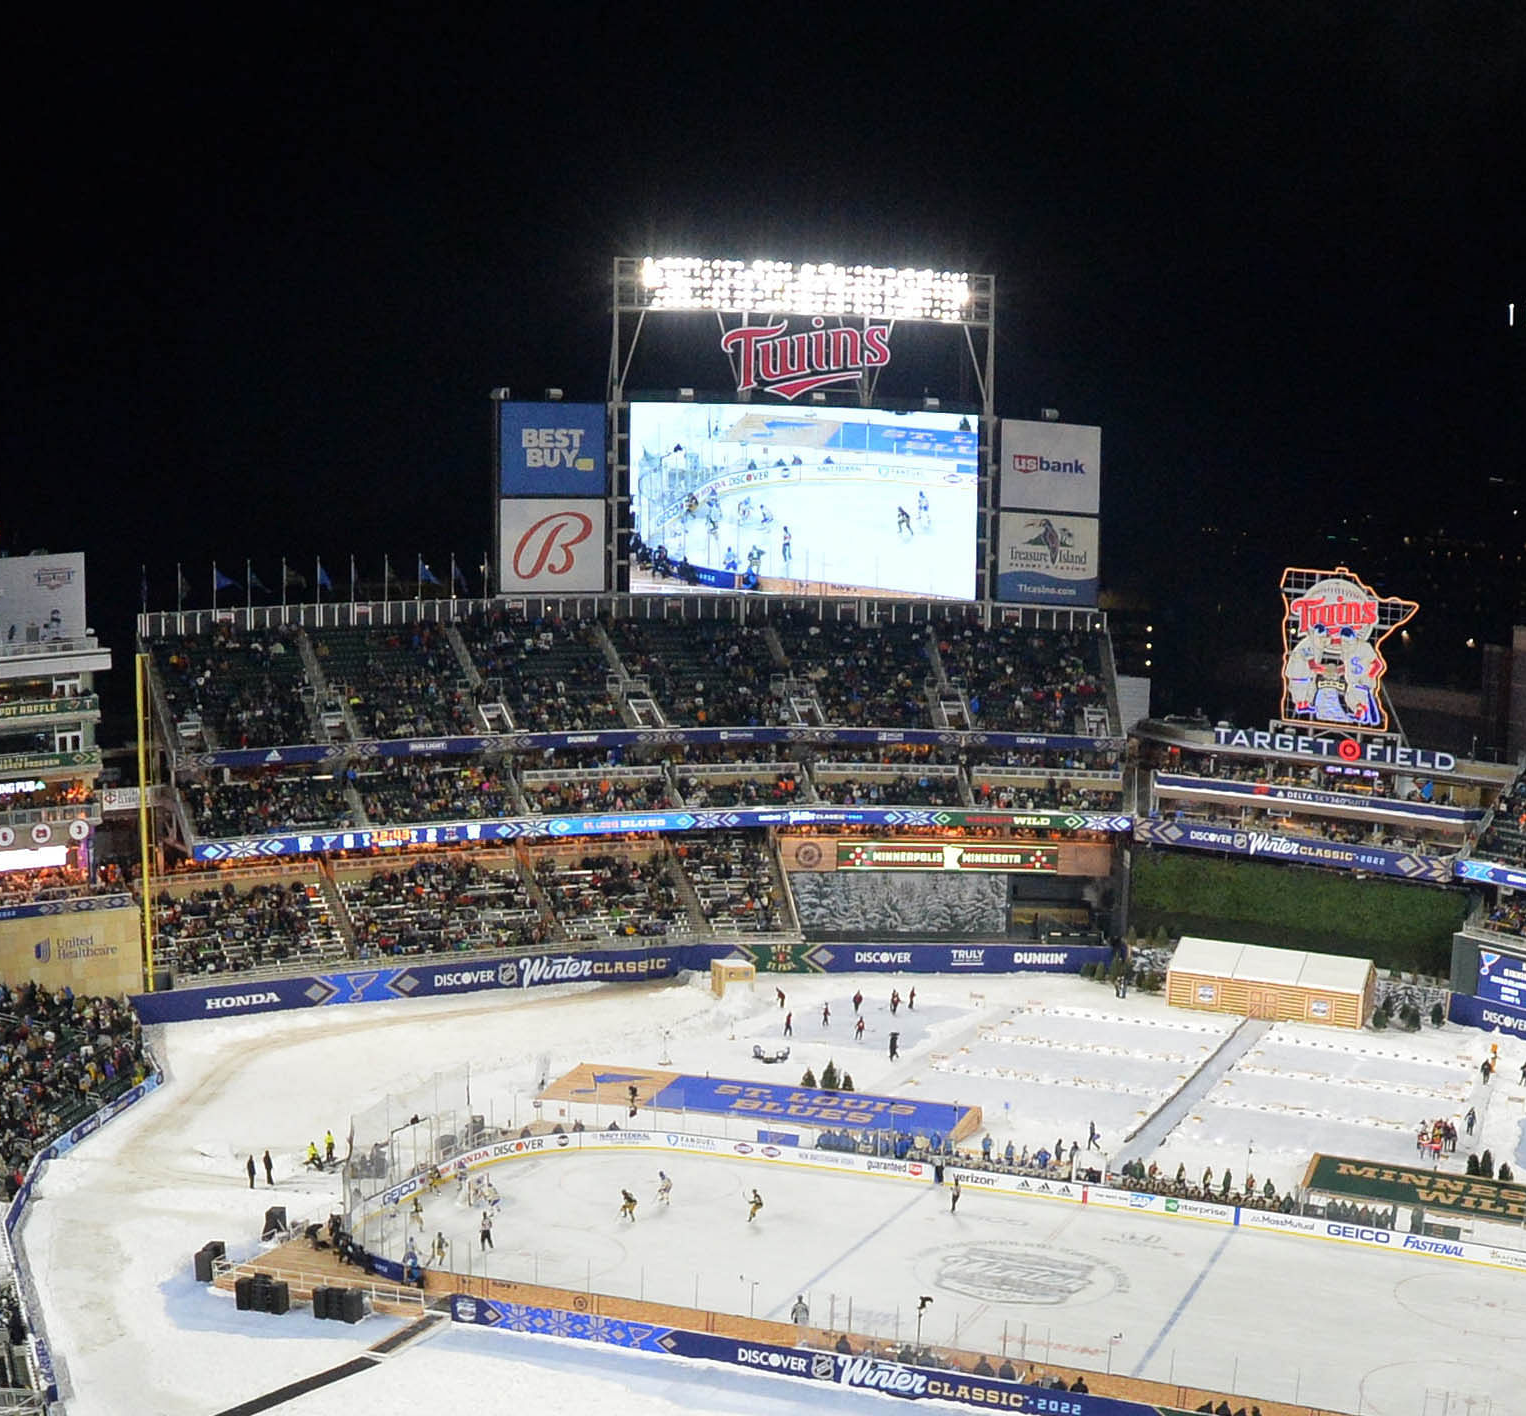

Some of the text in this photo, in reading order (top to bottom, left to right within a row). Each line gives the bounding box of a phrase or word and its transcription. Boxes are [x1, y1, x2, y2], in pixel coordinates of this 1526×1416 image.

[721, 316, 891, 396] Twins
[522, 429, 584, 448] BEST
[526, 448, 578, 468] BUY
[1009, 546, 1086, 566] Treasure Island
[1292, 595, 1377, 633] Twins
[20, 703, 56, 714] RAFFLE
[1214, 727, 1334, 757] TARGET
[1367, 743, 1456, 771] FIELD
[16, 780, 35, 793] PUB
[1287, 790, 1313, 801] DELTA
[621, 817, 666, 828] BLUES
[1013, 815, 1050, 826] WILD
[1190, 830, 1232, 846] DISCOVER
[1248, 831, 1299, 855] Winter
[1299, 846, 1353, 861] CLASSIC
[873, 851, 1021, 865] MINNEAPOLIS MINNESOTA
[57, 935, 93, 948] United
[58, 946, 118, 959] Healthcare
[855, 951, 912, 964] DISCOVER
[951, 950, 985, 962] TRULY
[1013, 952, 1068, 965] DUNKIN'
[434, 955, 668, 989] DISCOVER Winter CLASSIC
[205, 991, 281, 1010] HONDA
[713, 1084, 917, 1116] ST. LOUIS
[729, 1099, 874, 1124] BLUES
[494, 1138, 544, 1157] DISCOVER
[680, 1134, 717, 1148] FANDUEL
[866, 1159, 907, 1174] guaranteed
[953, 1171, 995, 1187] verizon
[382, 1179, 416, 1206] GEICO
[1261, 1215, 1315, 1231] MassMutual
[1327, 1223, 1391, 1244] GEICO
[737, 1347, 1082, 1416] DISCOVER Winter CLASSIC 2022
